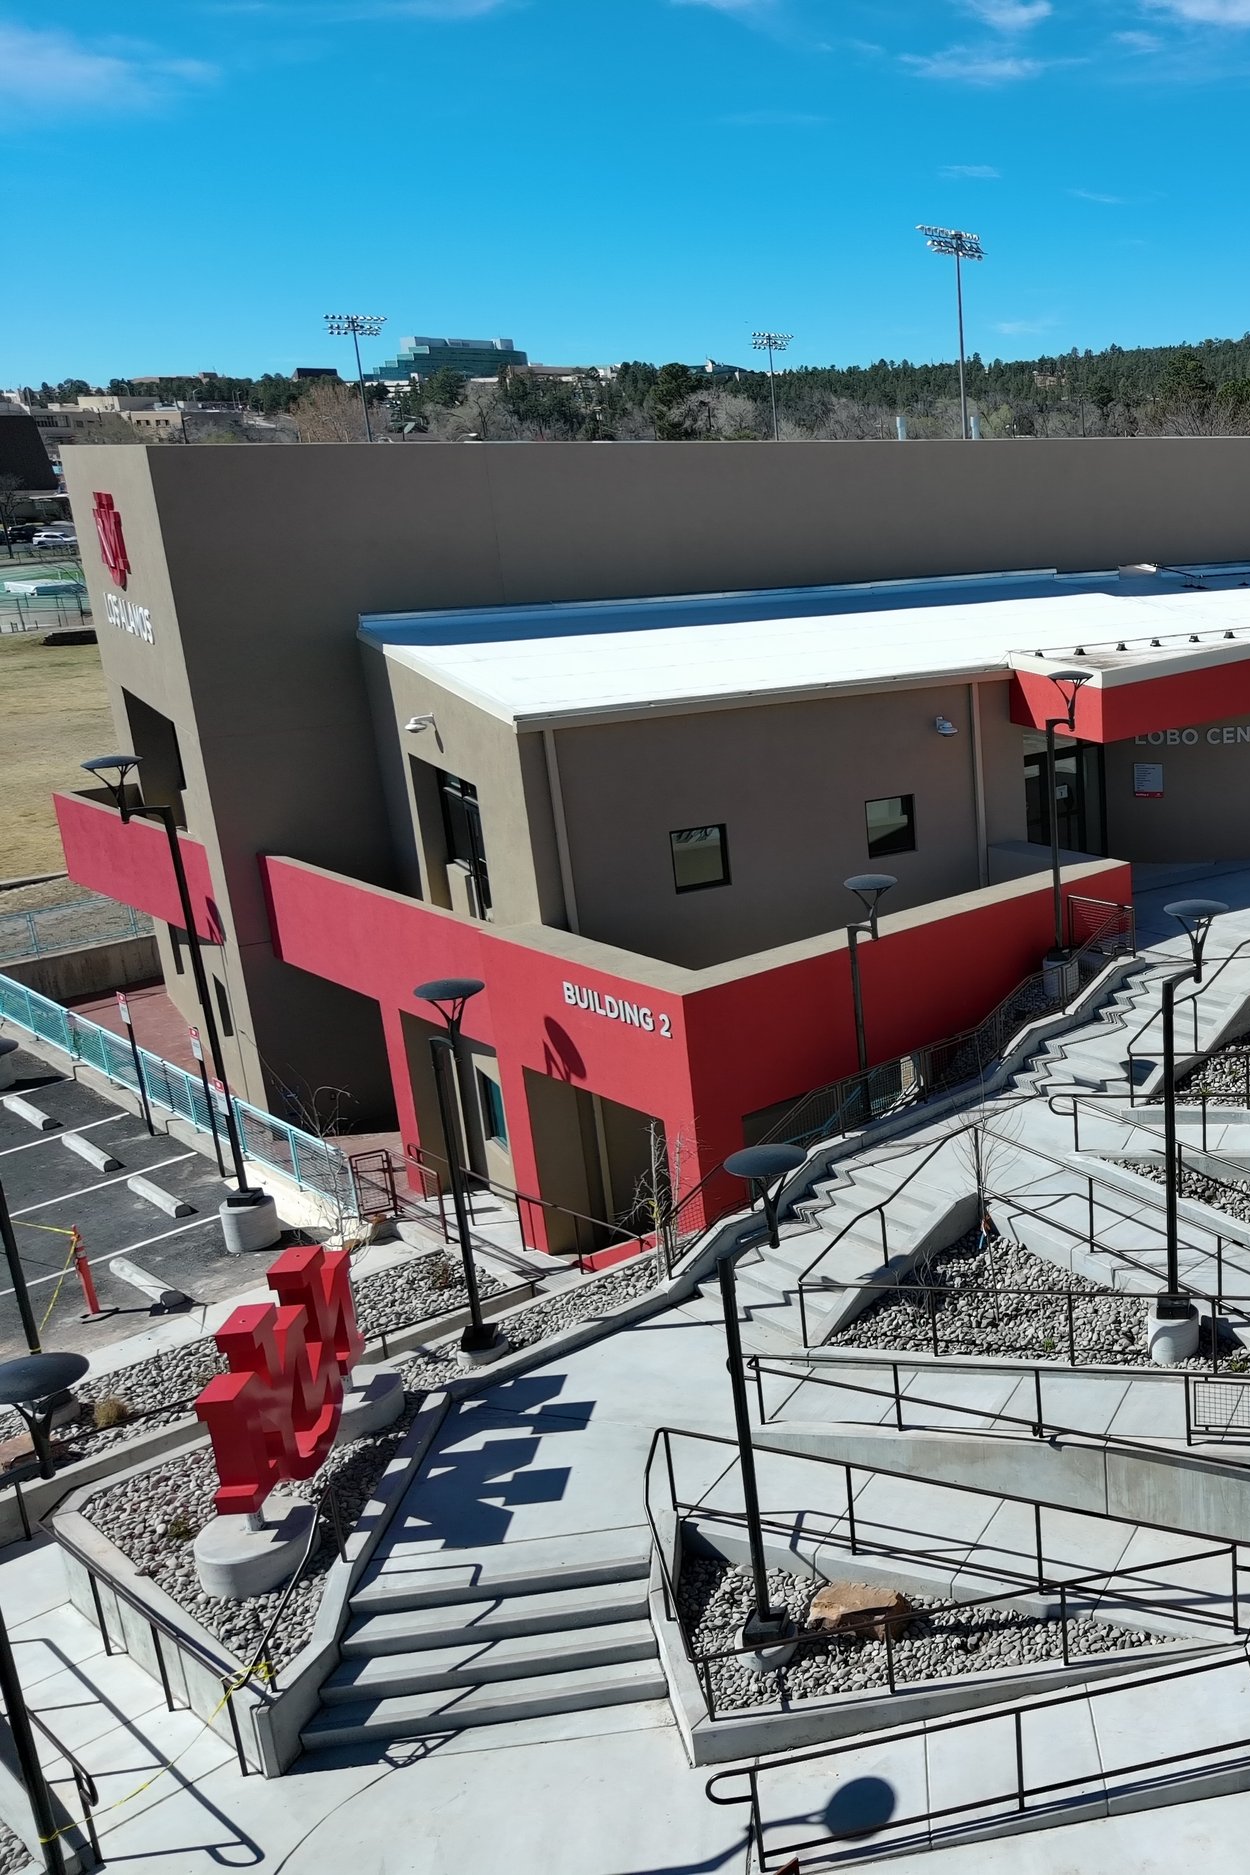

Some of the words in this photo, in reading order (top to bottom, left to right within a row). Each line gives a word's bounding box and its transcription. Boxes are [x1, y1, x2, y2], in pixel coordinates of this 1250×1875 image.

[103, 592, 120, 628] LOS
[118, 598, 155, 645] ALAMOS
[1135, 728, 1199, 745] LOBO
[563, 981, 654, 1032] BUILDING
[659, 1013, 672, 1038] 2
